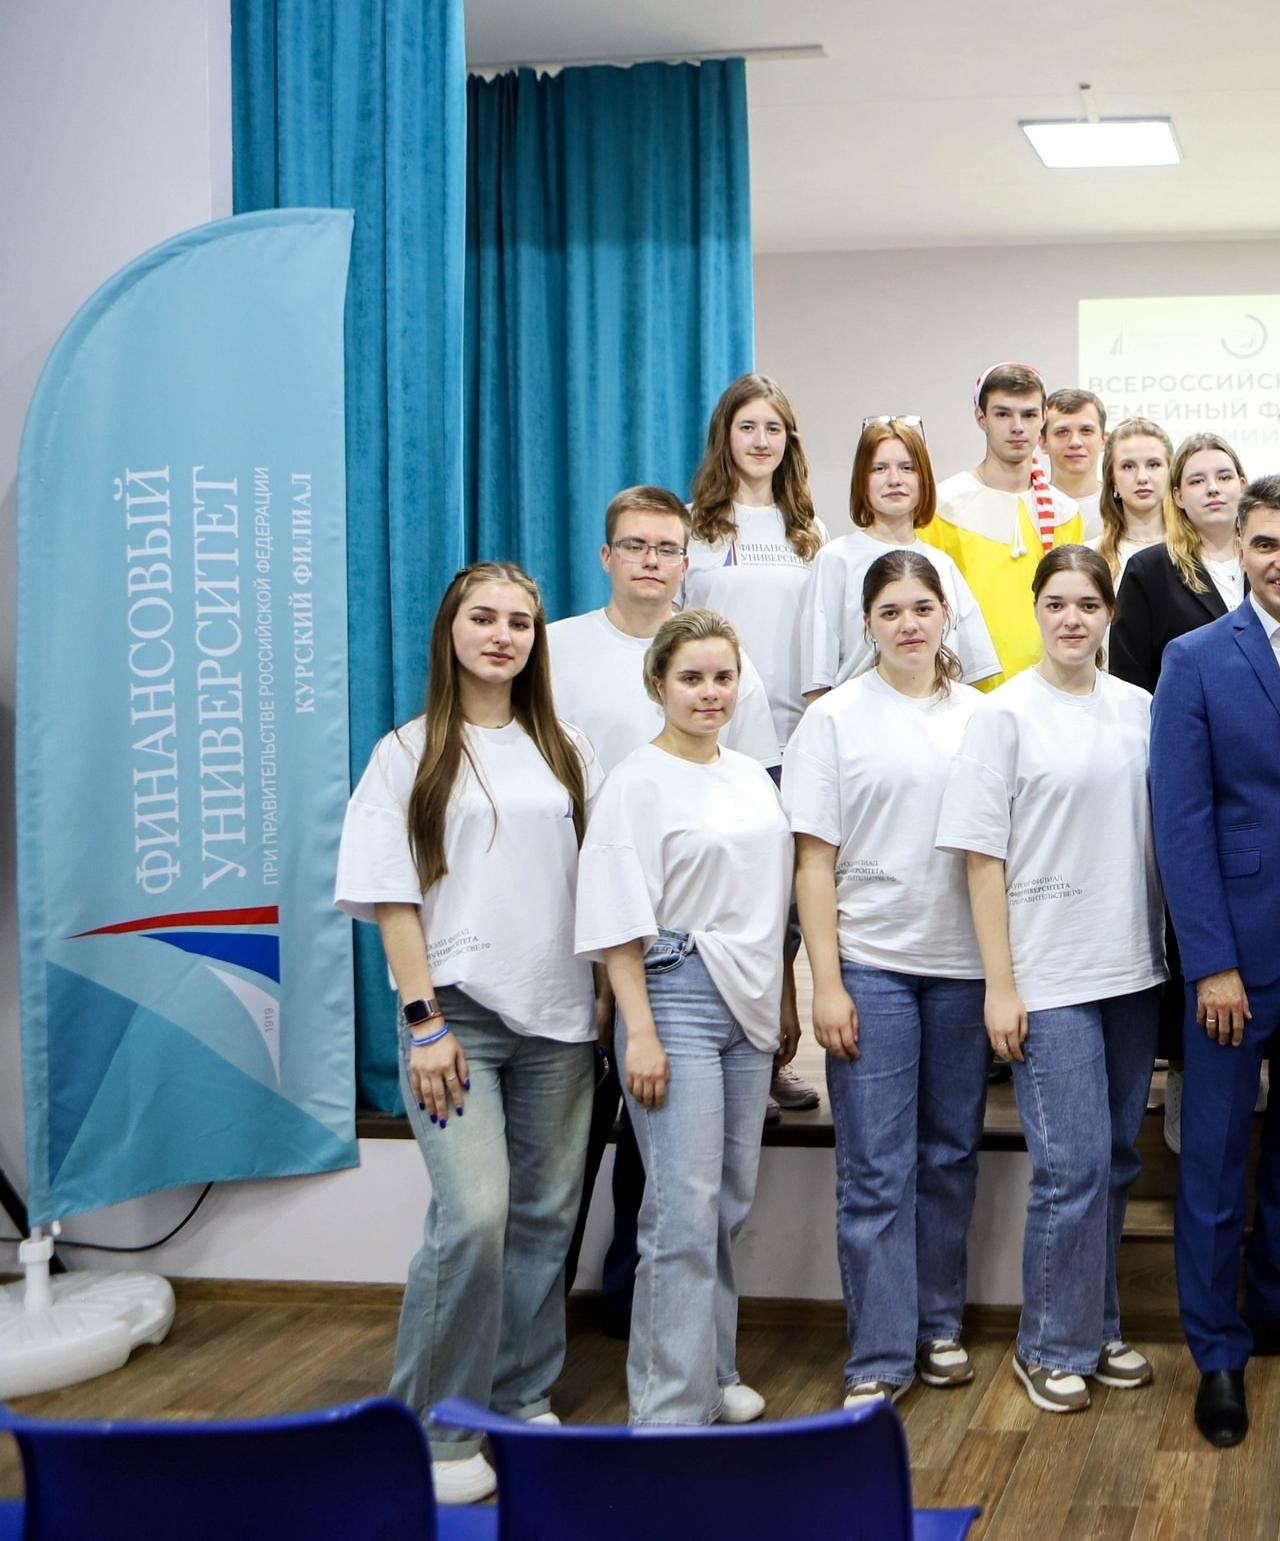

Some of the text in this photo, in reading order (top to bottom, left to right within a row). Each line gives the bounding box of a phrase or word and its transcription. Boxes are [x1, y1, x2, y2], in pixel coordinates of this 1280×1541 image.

[1107, 397, 1248, 422] ЕМЕЙНЫЙ
[112, 464, 182, 895] ФИНАНСОВЫЙ
[191, 465, 248, 890] УНИВЕРСИТЕТ
[253, 466, 280, 886] ПРИ ПРАВИТЕЛЬСТВЕ РОССИЙСКОЙ ФЕДЕРАЦИИ
[288, 472, 316, 714] КУРСКИЙ ФИЛИАЛ
[263, 1007, 275, 1033] 1919
